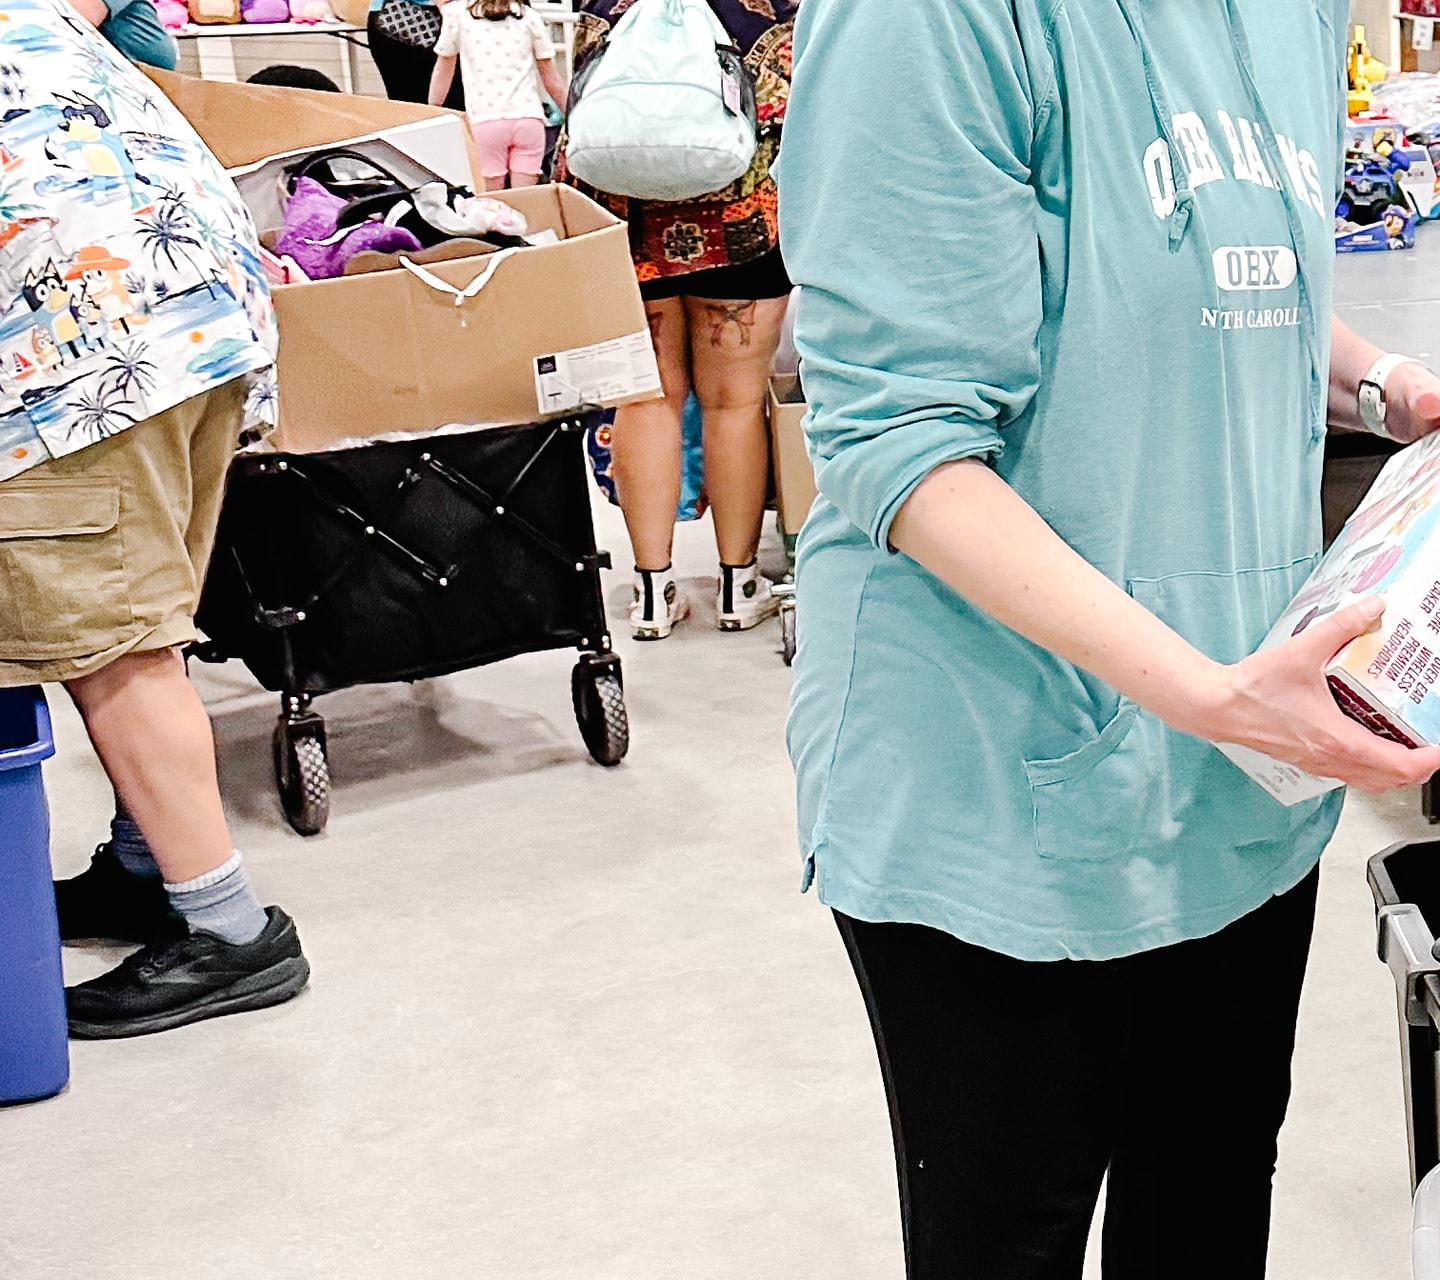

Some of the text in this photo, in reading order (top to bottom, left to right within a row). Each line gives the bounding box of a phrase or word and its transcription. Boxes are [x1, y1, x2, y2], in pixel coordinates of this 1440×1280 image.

[1226, 250, 1280, 287] OBX
[1367, 617, 1413, 680] HEADPHONES
[1385, 636, 1421, 682] PREMIUM
[1397, 646, 1434, 694] WIRELESS
